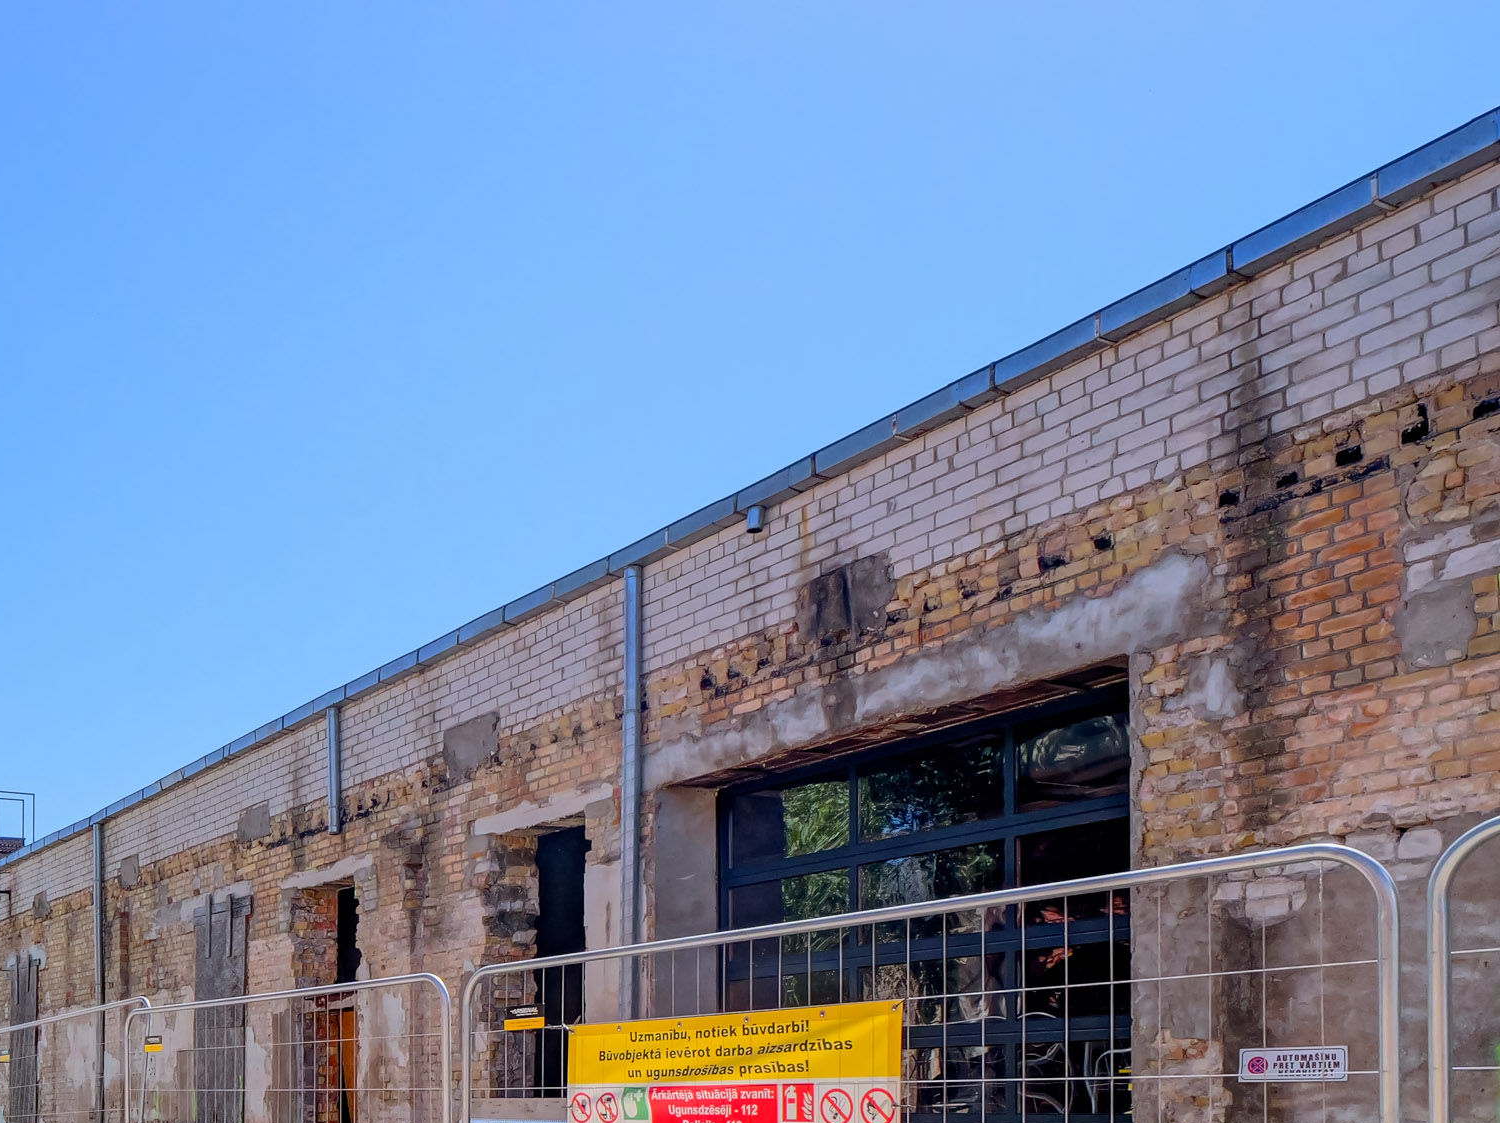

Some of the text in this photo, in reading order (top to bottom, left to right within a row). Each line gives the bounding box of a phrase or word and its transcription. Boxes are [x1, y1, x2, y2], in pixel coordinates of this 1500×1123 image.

[630, 1019, 810, 1042] Uzmanību, notiek būvdarbi!
[599, 1037, 853, 1062] Būvobjektā ievērot darba aizsardzības
[628, 1059, 810, 1080] un ugunsdrošības prasības!
[1299, 1060, 1340, 1069] VĀRTIEM
[696, 1088, 738, 1102] situācijā
[740, 1088, 774, 1100] zvanīt:
[668, 1104, 732, 1118] Ugunsdzēsēji
[741, 1104, 758, 1116] 112
